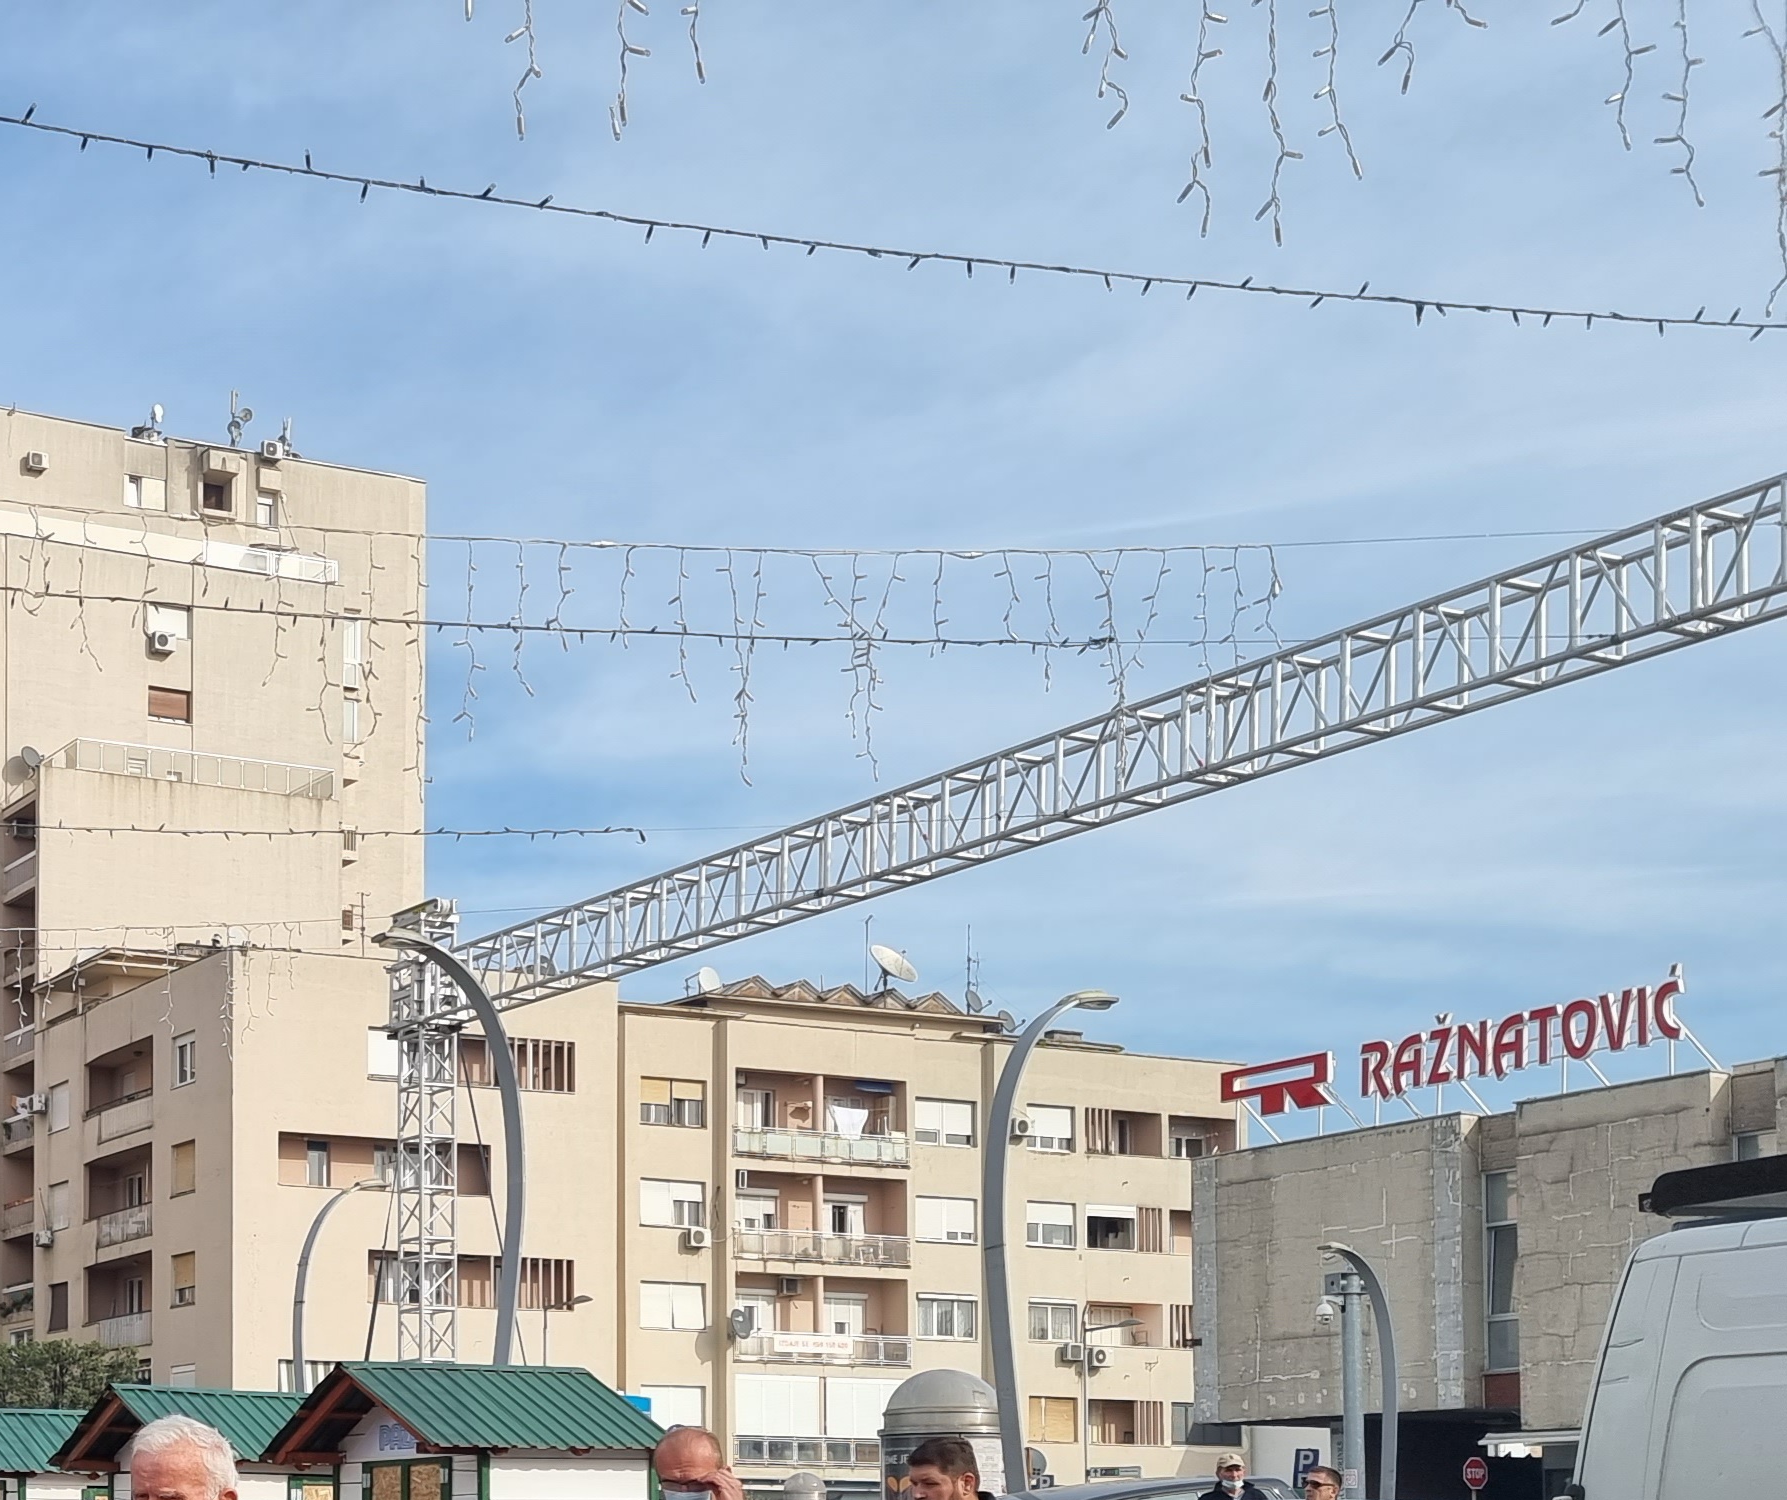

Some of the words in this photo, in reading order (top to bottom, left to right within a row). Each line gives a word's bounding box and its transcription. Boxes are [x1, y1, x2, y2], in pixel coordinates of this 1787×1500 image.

[1360, 963, 1685, 1101] RAŽNATOVIĆ
[1298, 1451, 1314, 1472] P
[1466, 1468, 1485, 1479] STOP
